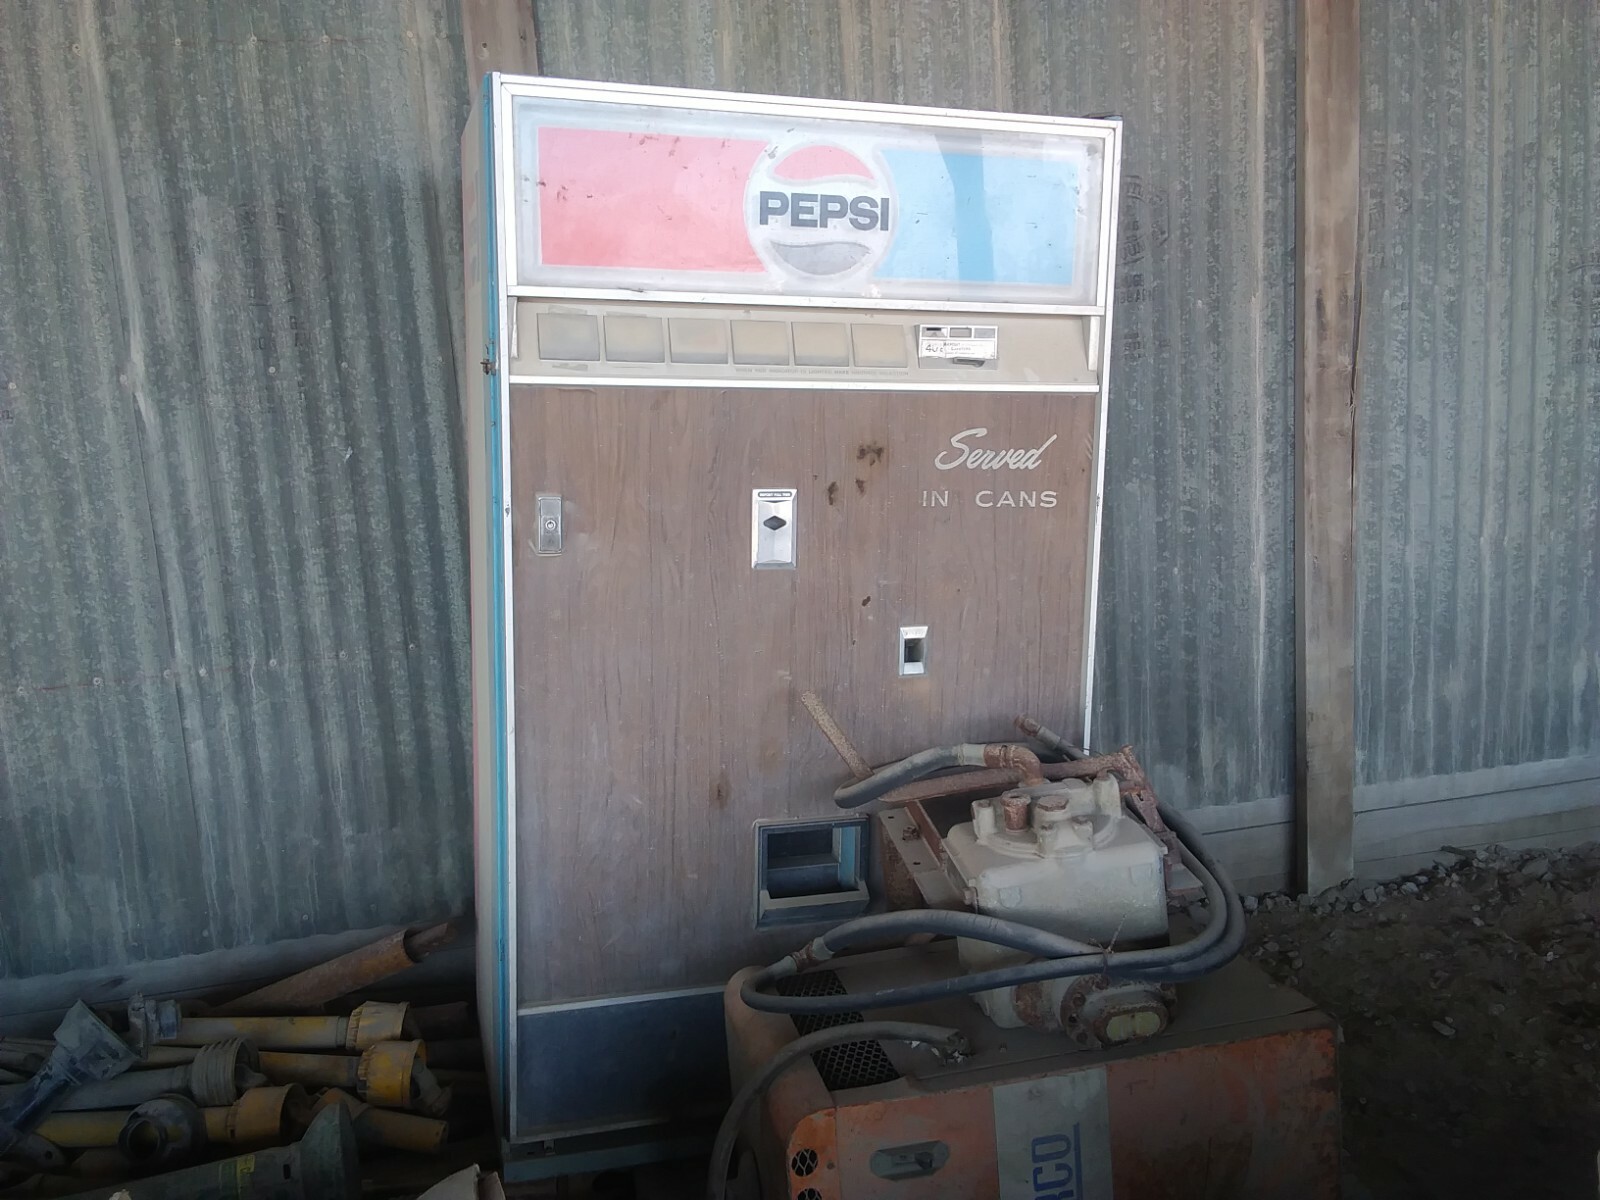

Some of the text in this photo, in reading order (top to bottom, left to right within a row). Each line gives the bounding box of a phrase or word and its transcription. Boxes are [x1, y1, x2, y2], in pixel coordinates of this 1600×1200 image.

[759, 191, 890, 231] PEPSI
[934, 427, 1058, 470] Served
[922, 490, 1059, 508] IN CANS
